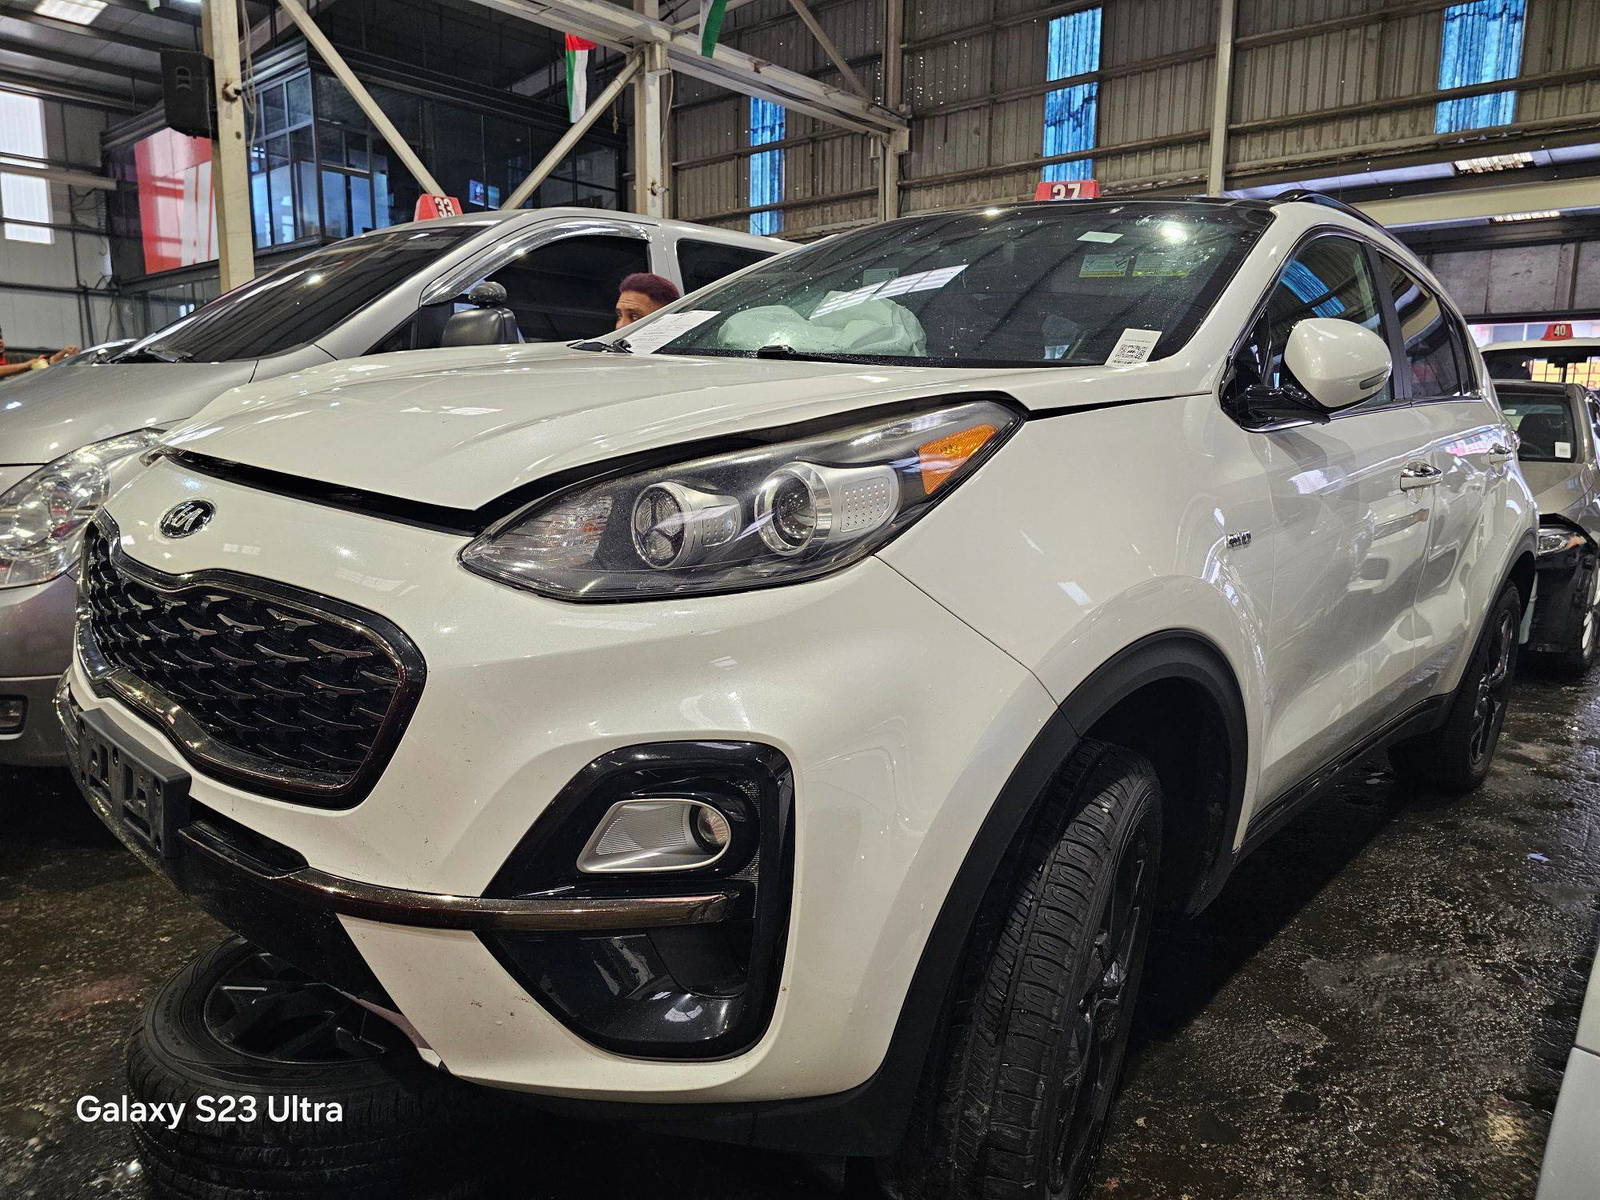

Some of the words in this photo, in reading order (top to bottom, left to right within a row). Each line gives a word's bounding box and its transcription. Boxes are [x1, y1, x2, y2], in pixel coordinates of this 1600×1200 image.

[434, 197, 456, 218] 33
[1554, 324, 1567, 336] 40
[163, 503, 205, 533] KIA
